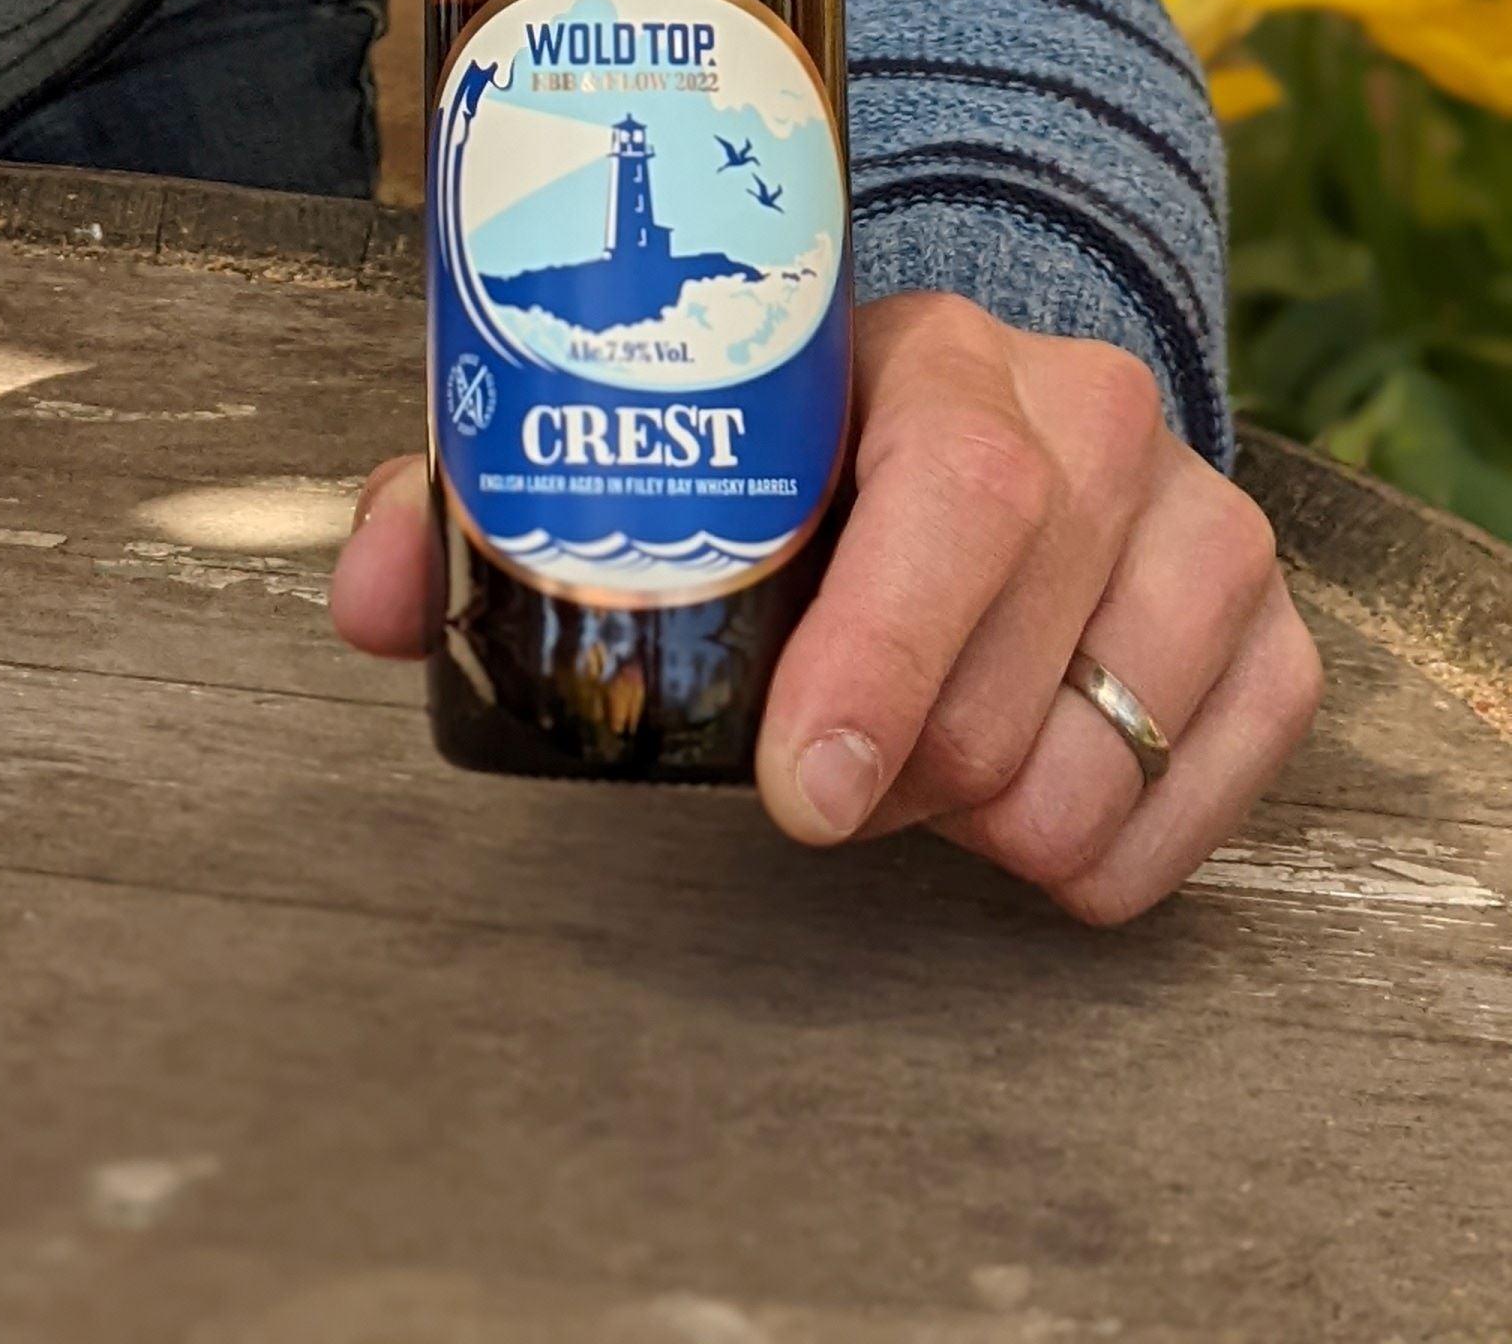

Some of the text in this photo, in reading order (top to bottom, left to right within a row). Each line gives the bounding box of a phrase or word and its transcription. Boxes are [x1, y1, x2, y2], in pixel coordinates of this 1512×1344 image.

[601, 72, 670, 92] FLOW
[674, 72, 720, 93] 2022
[654, 340, 696, 363] Vol.
[521, 403, 746, 468] CREST
[607, 476, 623, 496] IN
[625, 476, 664, 496] FILEY
[667, 477, 693, 496] BAY
[695, 477, 746, 497] WHISKY
[747, 477, 799, 497] BARRELS
